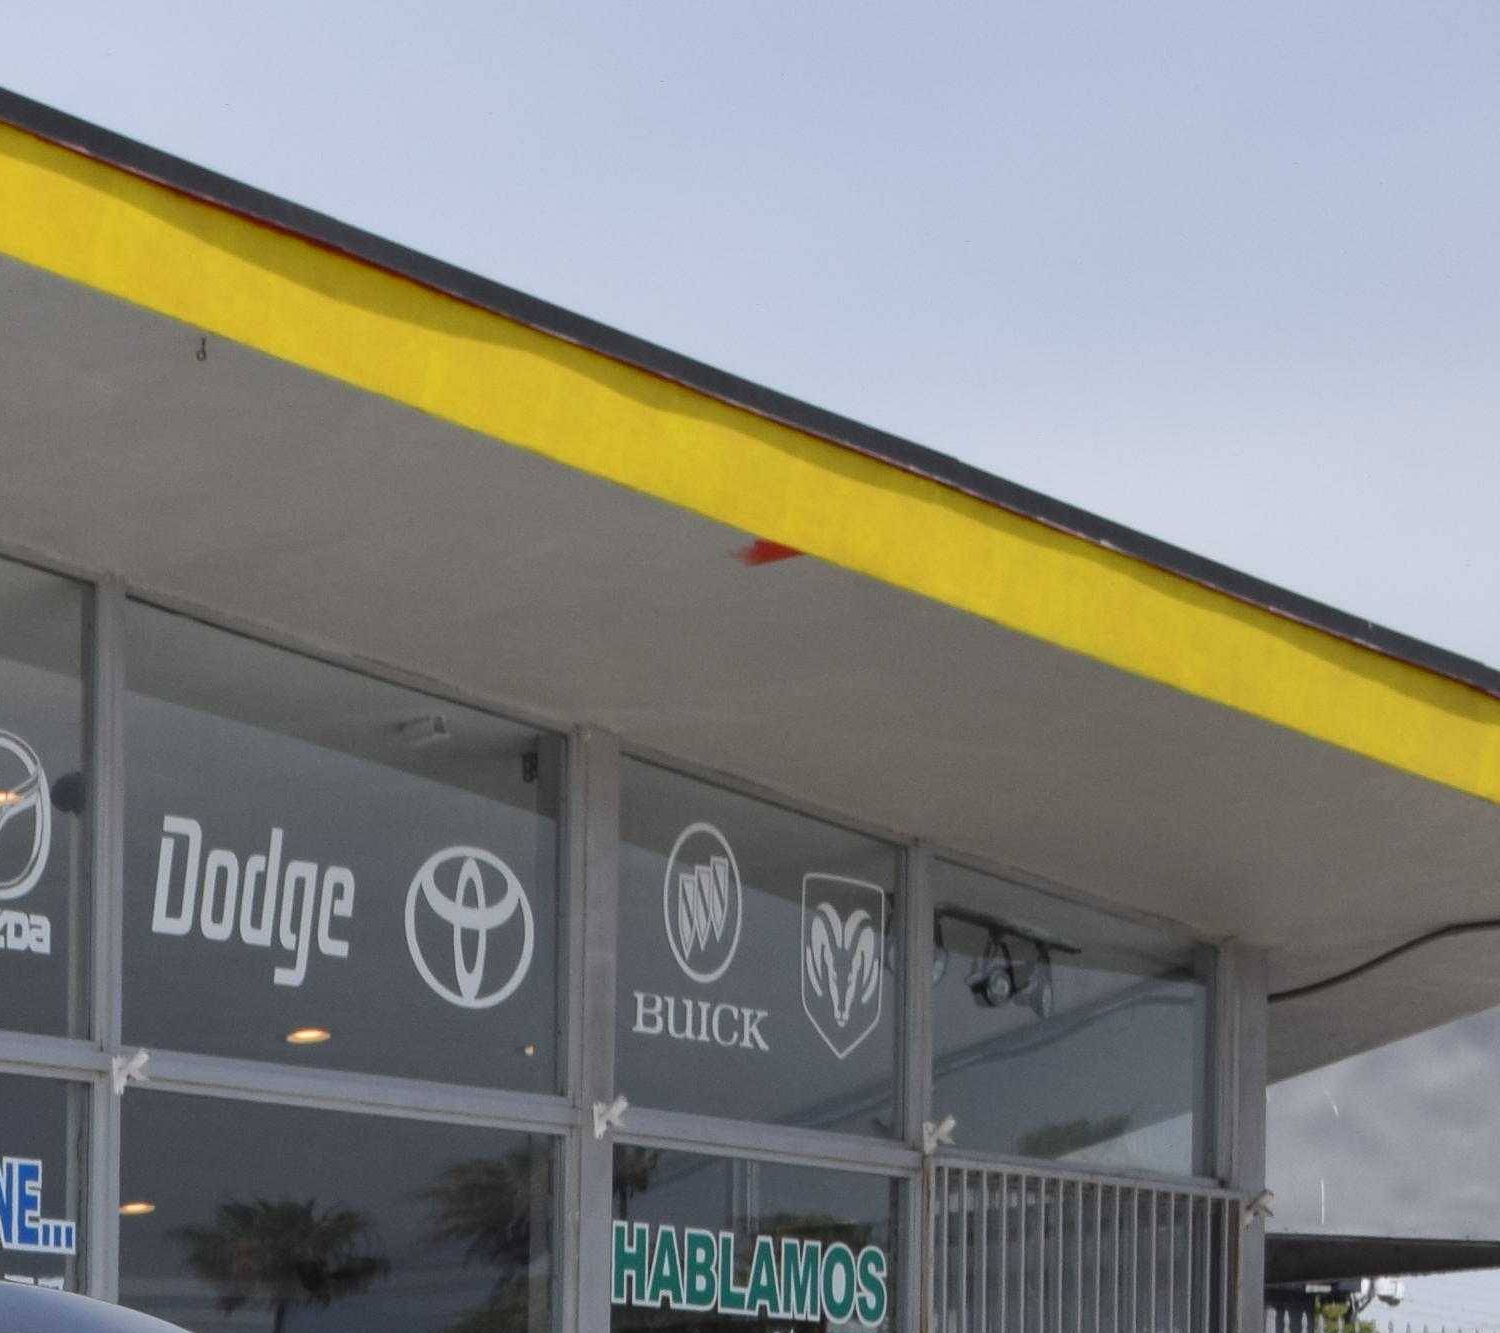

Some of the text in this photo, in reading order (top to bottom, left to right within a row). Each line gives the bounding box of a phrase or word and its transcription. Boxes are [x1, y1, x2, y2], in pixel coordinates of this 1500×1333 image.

[152, 813, 356, 986] Dodge
[631, 991, 770, 1054] BUICK
[610, 1221, 889, 1326] HABLAMOS
